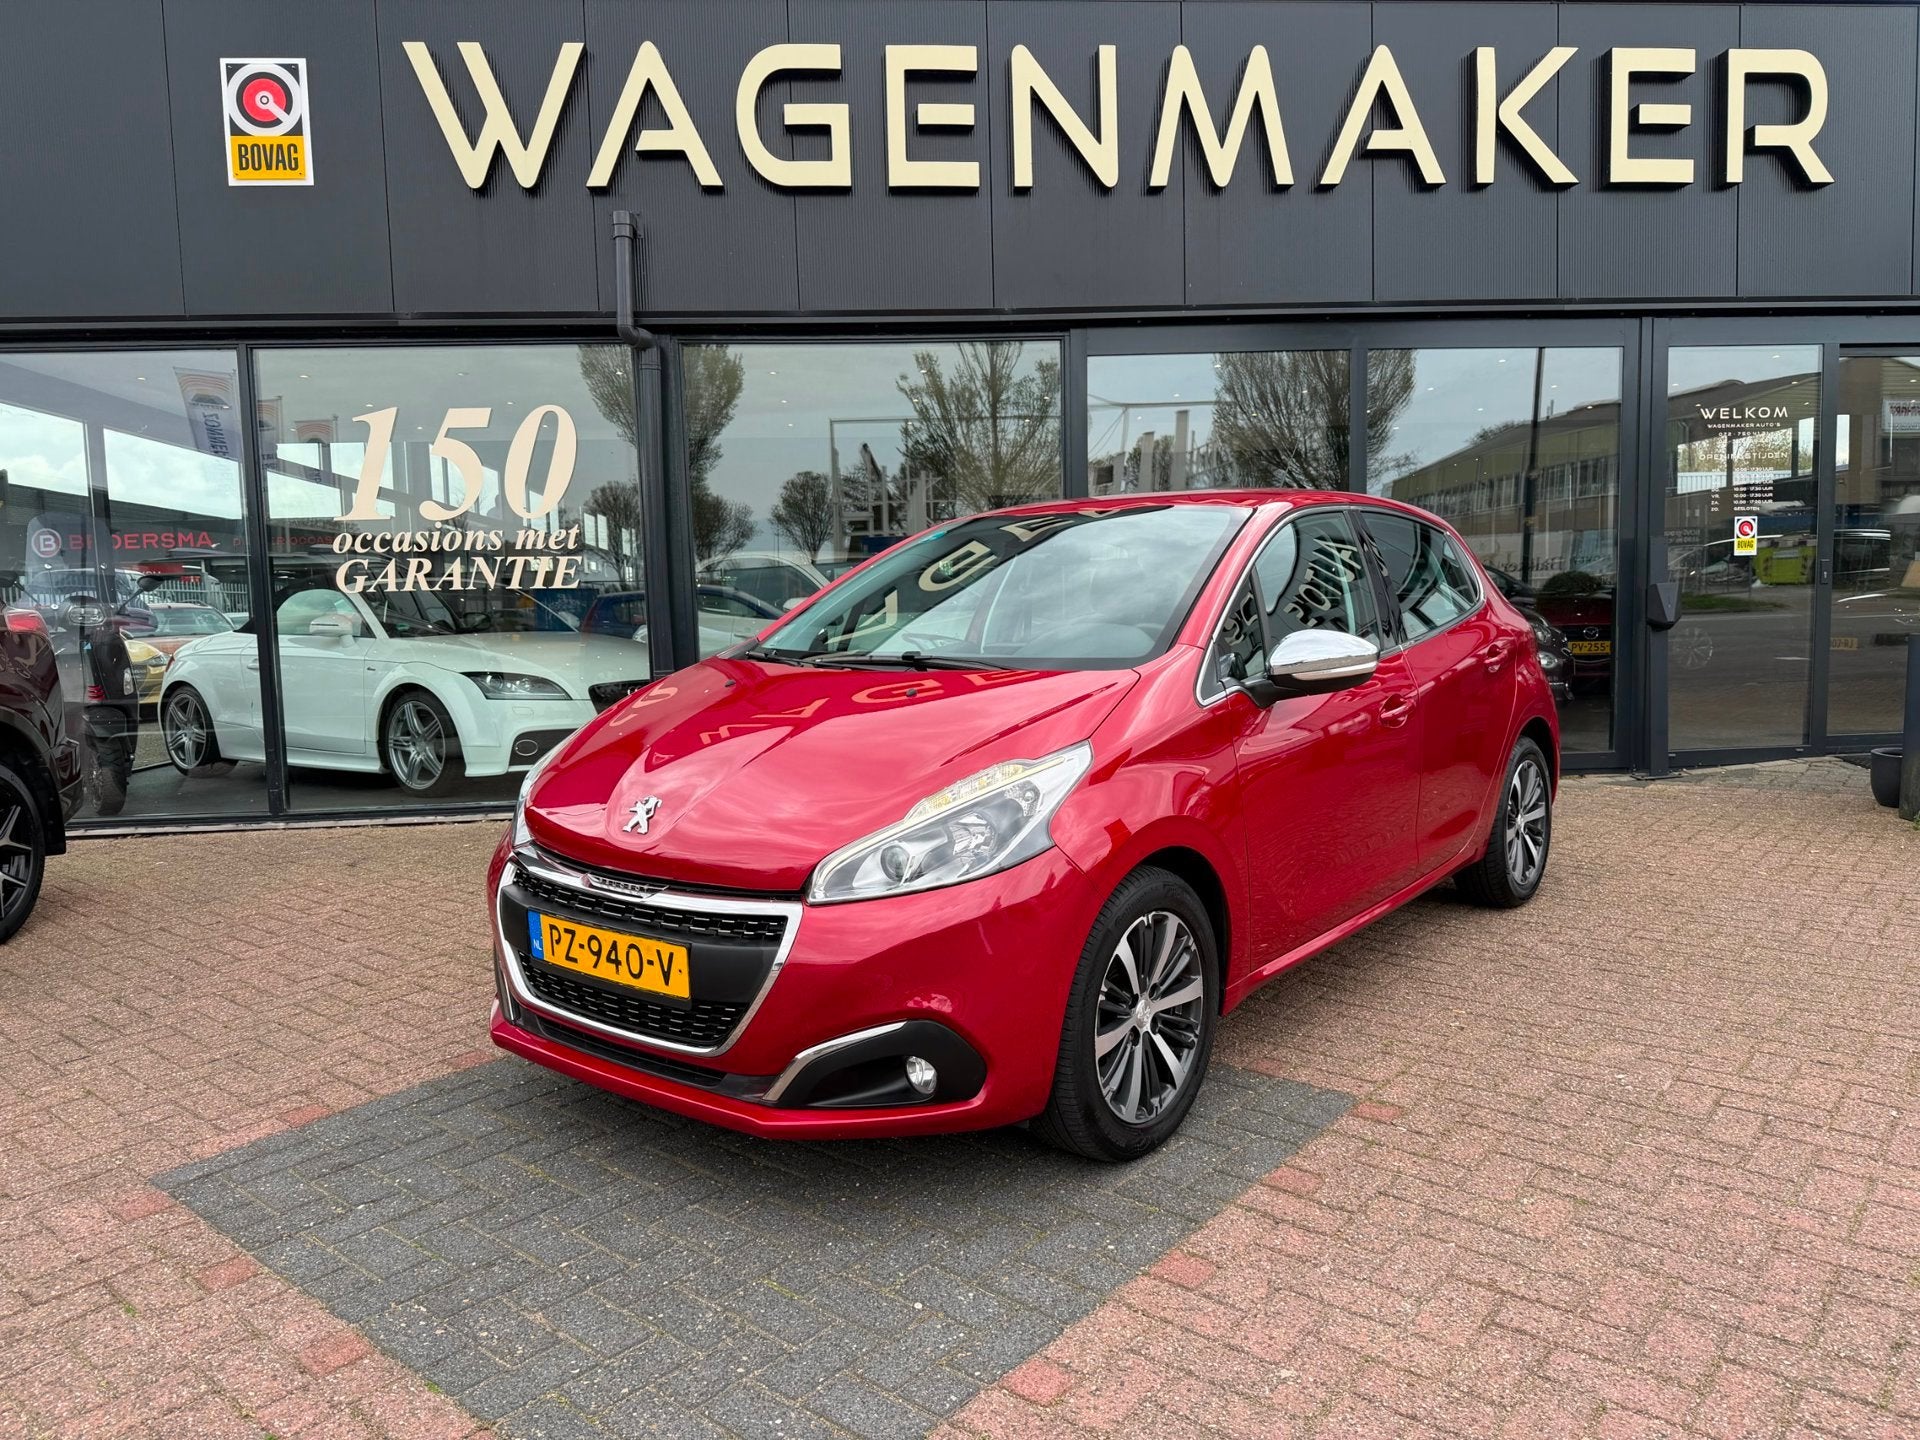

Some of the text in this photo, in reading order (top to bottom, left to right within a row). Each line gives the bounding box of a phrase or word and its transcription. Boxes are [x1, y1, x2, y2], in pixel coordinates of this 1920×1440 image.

[403, 41, 1834, 190] WAGENMAKER
[237, 143, 299, 171] BOVAG
[1700, 406, 1788, 420] WELKOM
[333, 404, 577, 521] 150
[332, 521, 580, 554] occasions met
[1737, 540, 1754, 549] BOVAG
[335, 555, 583, 594] GARANTIE
[533, 939, 542, 951] NL
[549, 923, 674, 986] PZ-940-V
